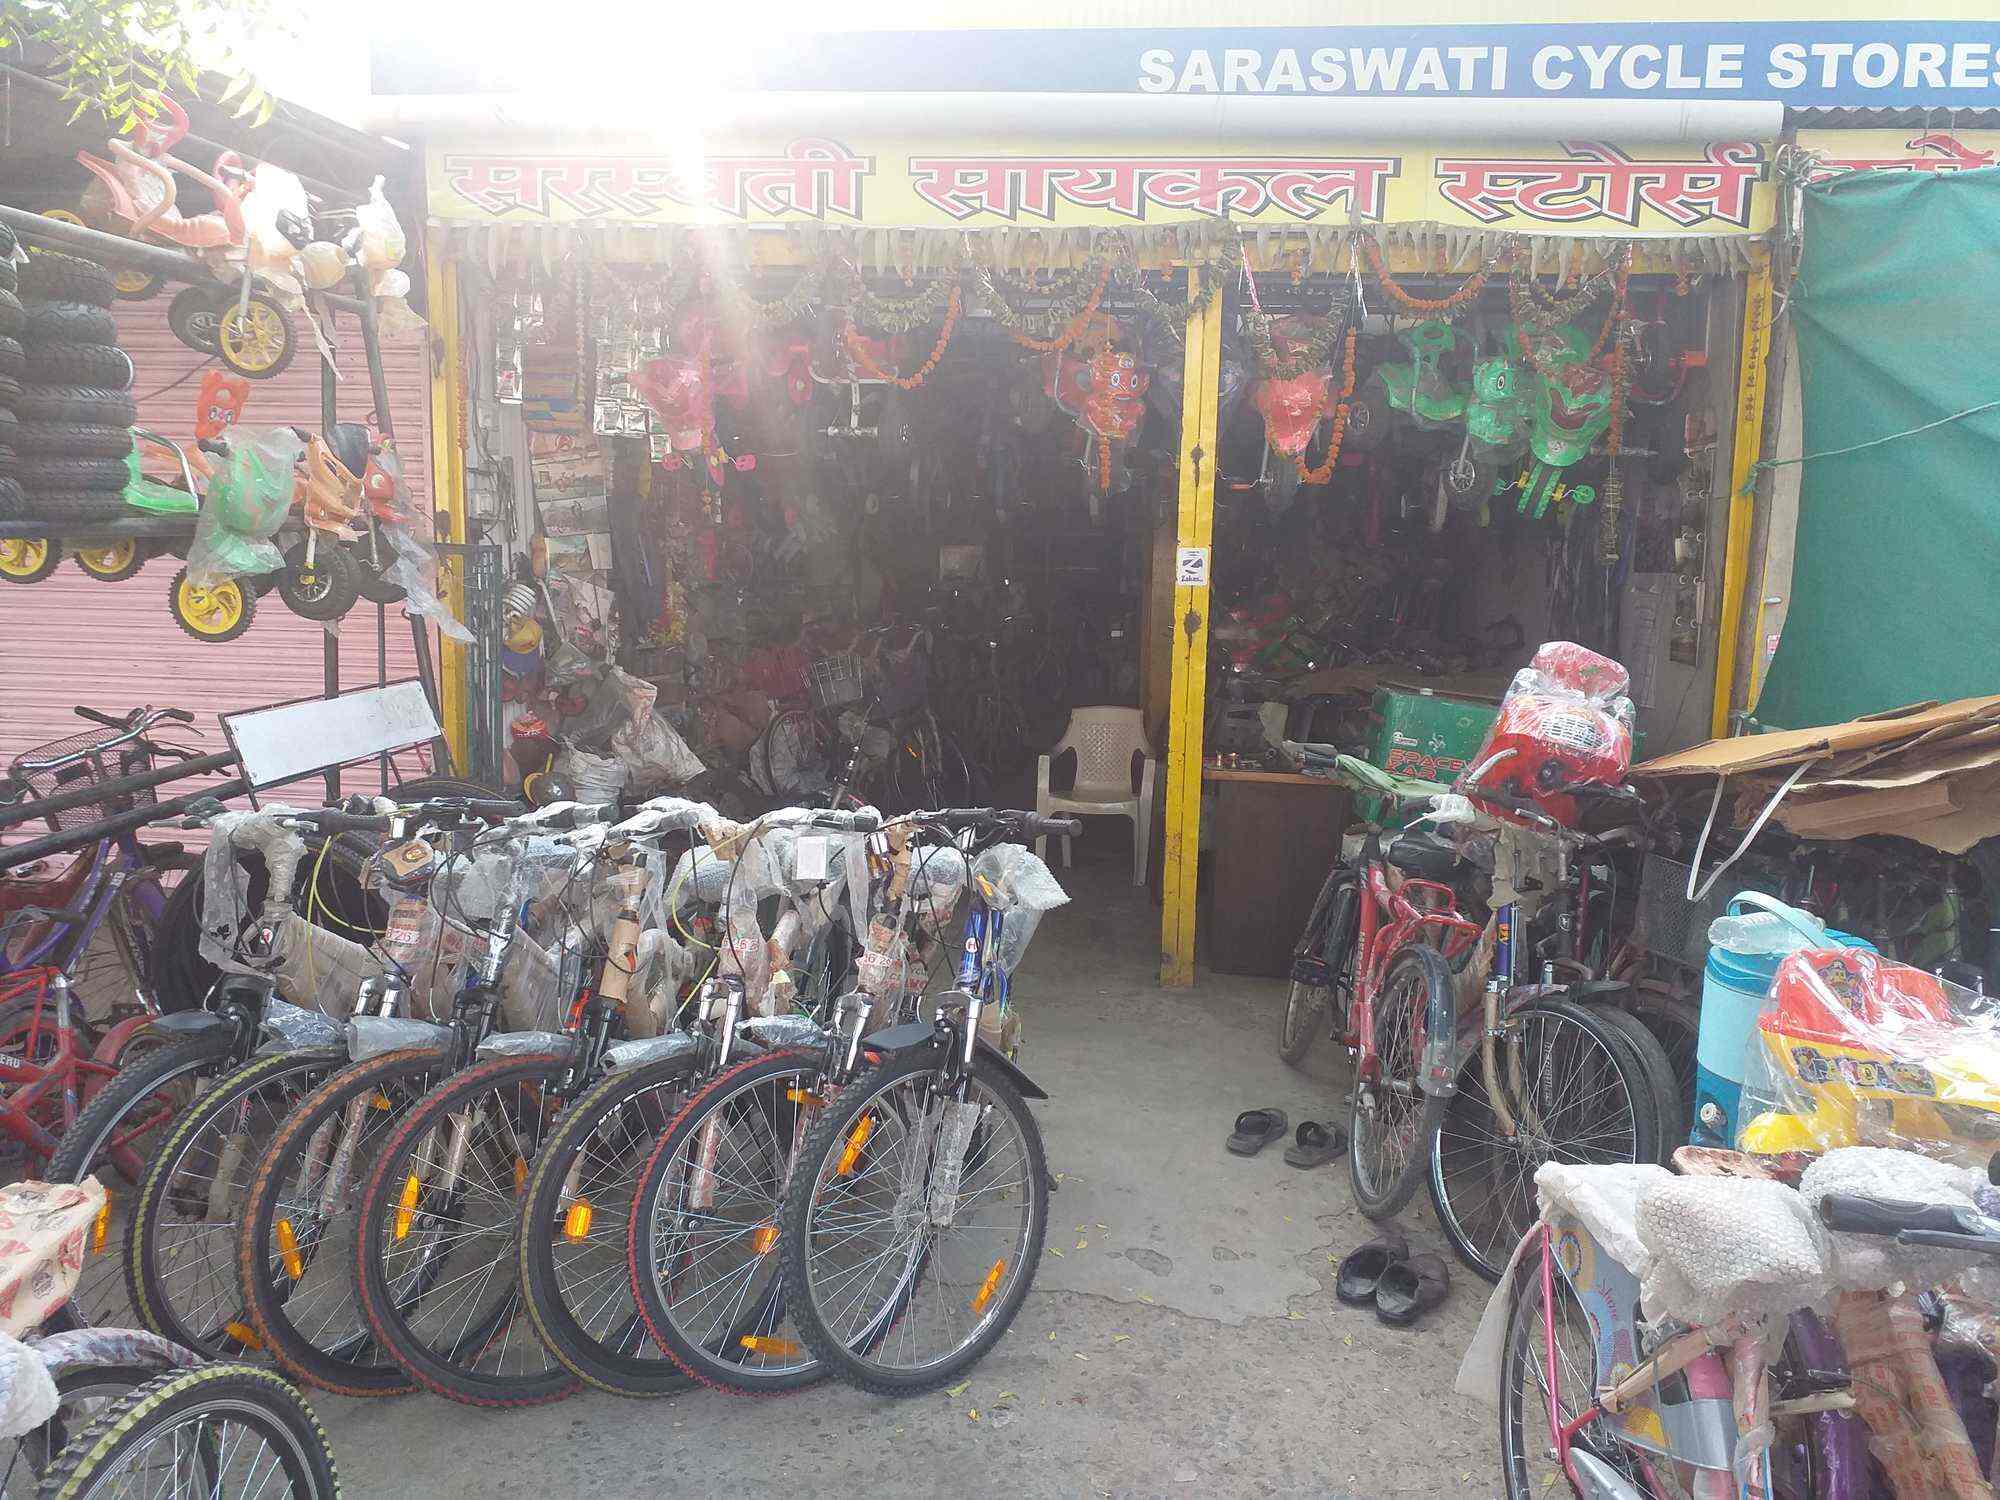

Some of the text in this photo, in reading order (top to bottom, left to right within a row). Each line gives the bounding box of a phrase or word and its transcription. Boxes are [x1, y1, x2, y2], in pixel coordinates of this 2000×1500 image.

[1138, 42, 2000, 93] SARASWATI CYCLE STORE
[908, 156, 1402, 222] सायकल
